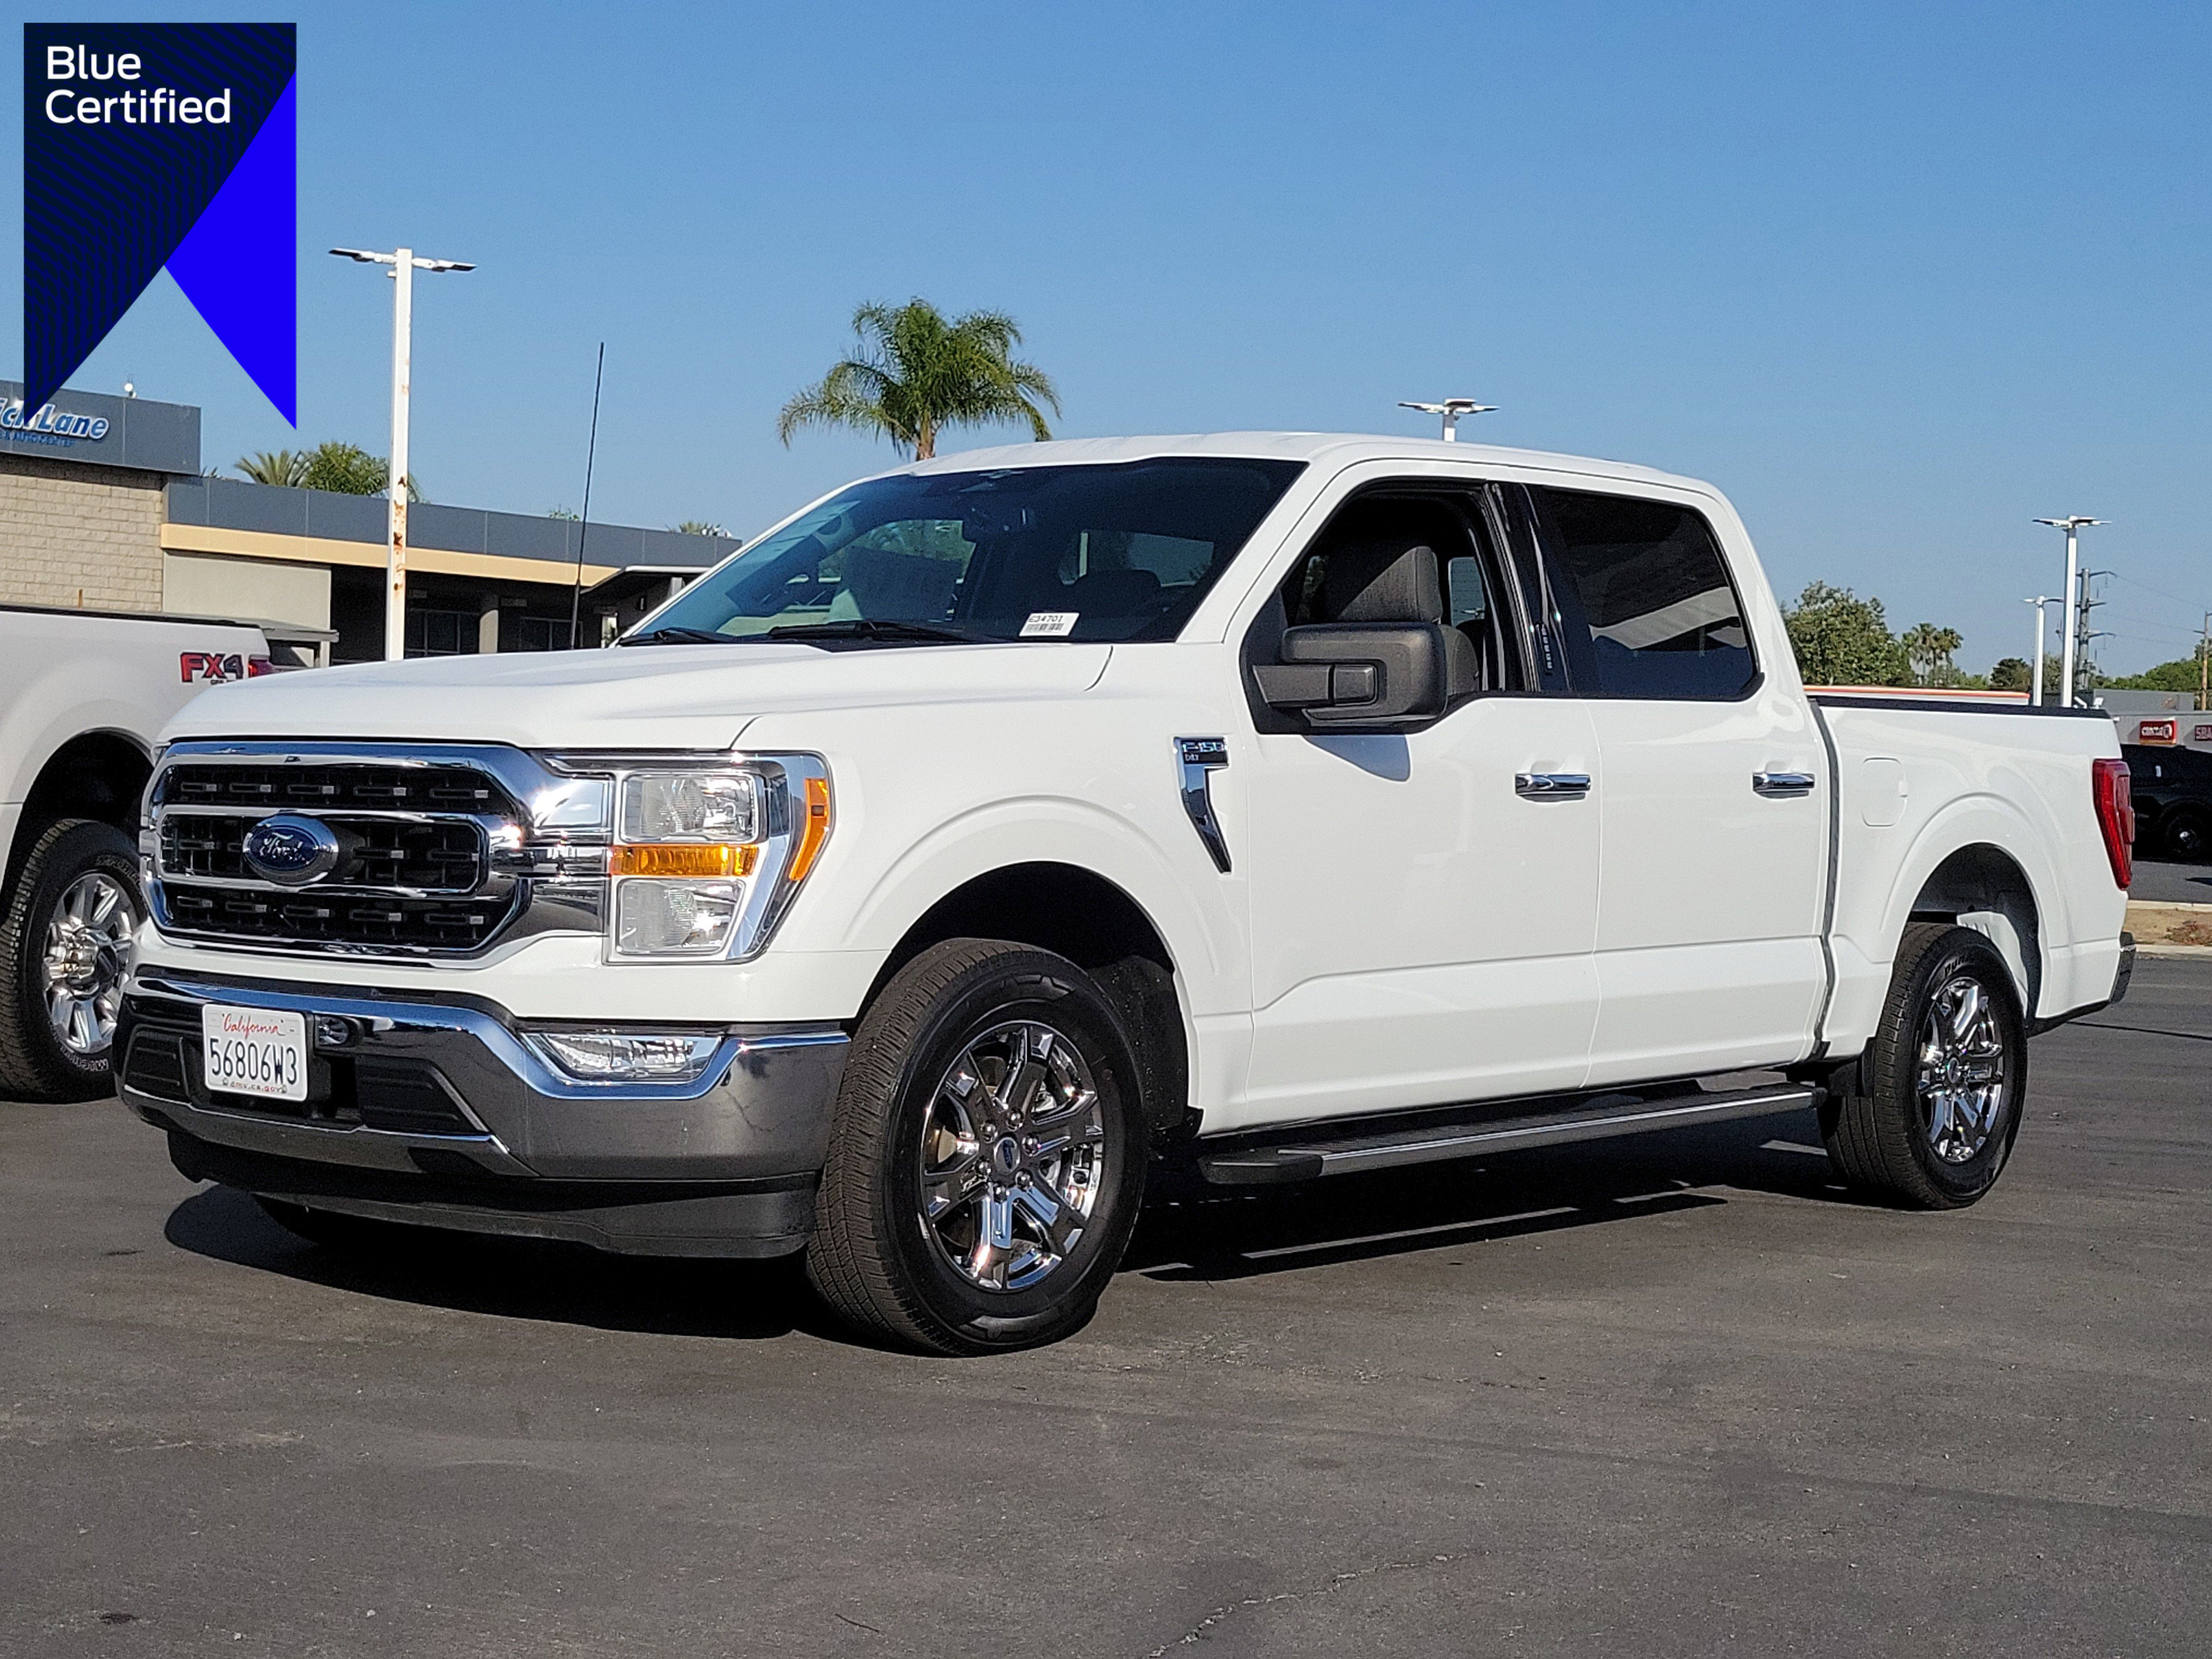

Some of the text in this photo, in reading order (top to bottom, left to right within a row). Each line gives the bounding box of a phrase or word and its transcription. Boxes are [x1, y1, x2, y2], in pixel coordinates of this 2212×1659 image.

[36, 404, 109, 439] Lane
[180, 651, 244, 683] FX4
[223, 1013, 286, 1040] California
[210, 1038, 297, 1085] 56806W3
